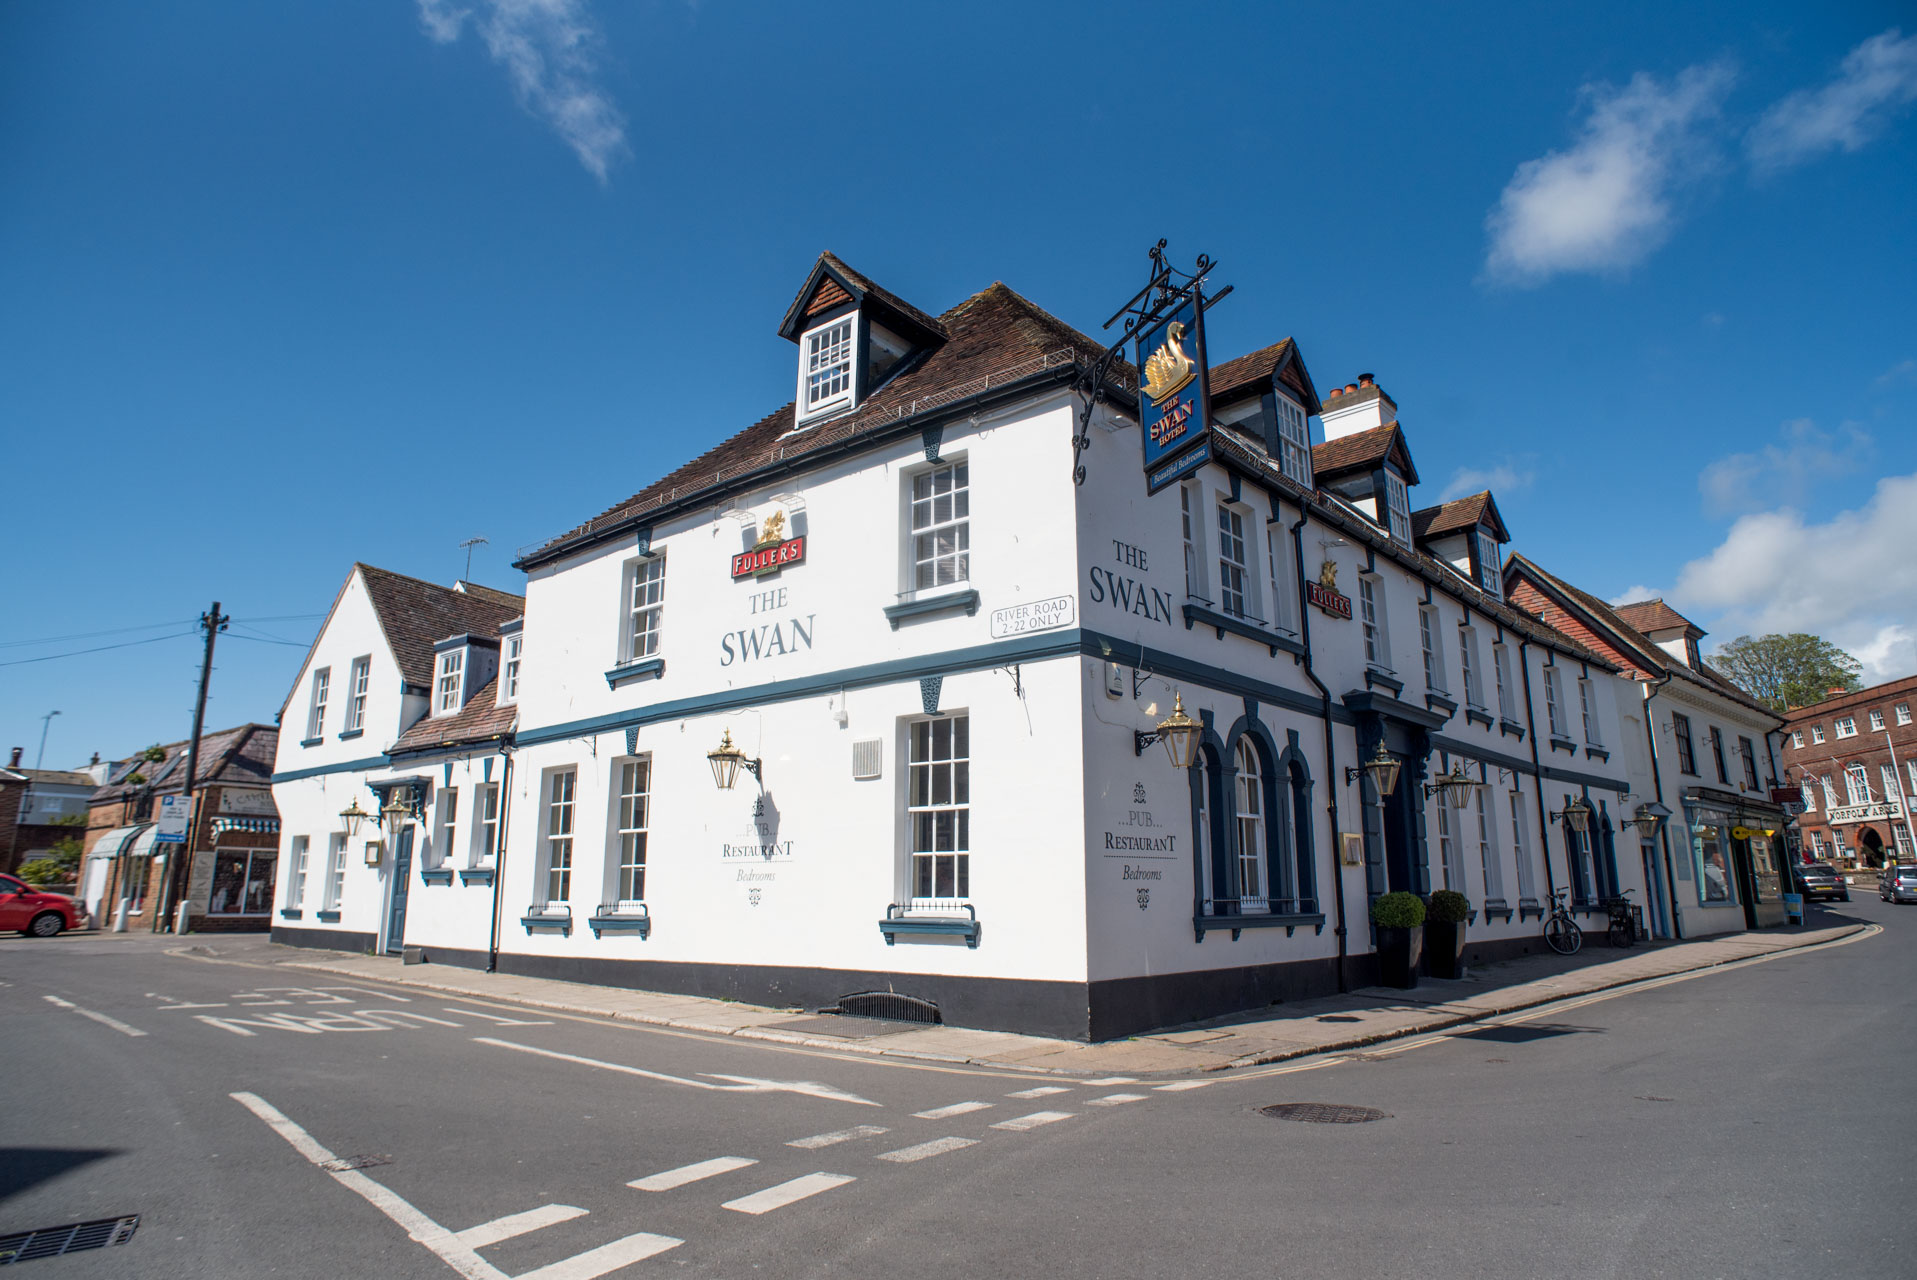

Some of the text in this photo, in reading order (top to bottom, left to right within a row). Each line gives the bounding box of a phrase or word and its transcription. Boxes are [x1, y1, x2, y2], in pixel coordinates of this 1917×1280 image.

[1162, 396, 1179, 413] THE
[1150, 399, 1194, 440] SWAN
[1159, 424, 1187, 447] HOTEL
[1154, 448, 1206, 484] Beautiful Bedrooms
[735, 543, 798, 573] FULLER'S
[1113, 539, 1148, 571] THE
[749, 587, 788, 615] THE
[1090, 566, 1172, 626] SWAN
[996, 599, 1067, 623] RIVER ROAD
[1029, 612, 1061, 628] ONLY
[720, 614, 816, 667] SWAN
[1829, 805, 1899, 820] NORFOLK ARMS
[723, 841, 793, 857] RESTAURANT
[1105, 831, 1176, 851] RESTAURANT
[736, 868, 776, 881] Bedrooms
[1123, 865, 1161, 880] Bedrooms
